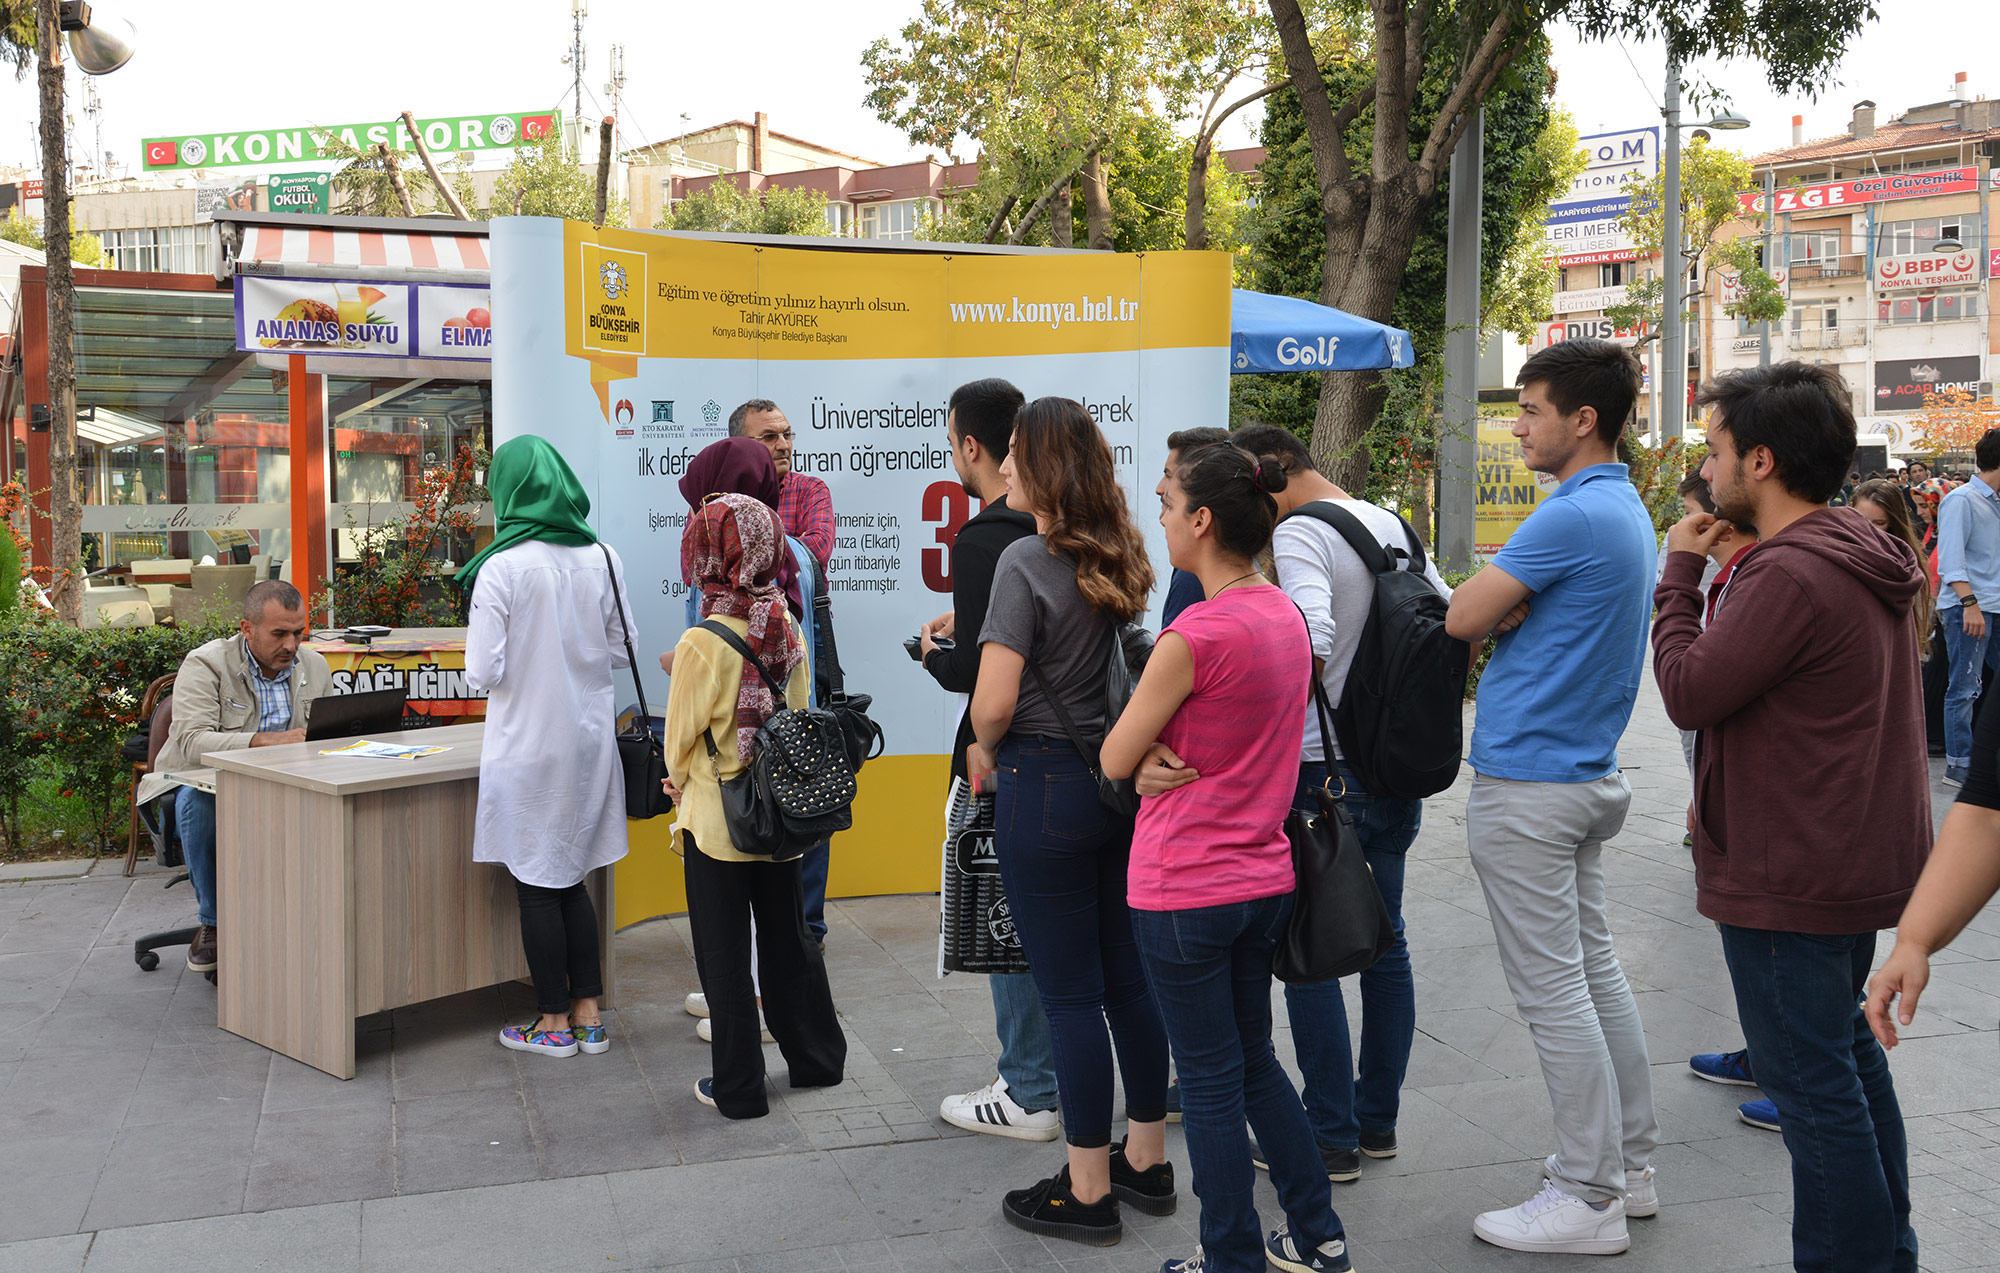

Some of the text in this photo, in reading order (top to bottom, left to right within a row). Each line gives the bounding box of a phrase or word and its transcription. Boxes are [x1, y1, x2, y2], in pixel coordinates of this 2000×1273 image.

[213, 120, 485, 164] KONYASPOR
[1597, 139, 1644, 160] OM
[283, 185, 311, 193] FUTBOL
[1853, 171, 1964, 193] Özel Güvenlik
[274, 193, 315, 205] OKULU
[1558, 207, 1591, 218] KARİYER
[1545, 223, 1578, 240] LERİ
[1580, 237, 1617, 250] LİSESİ
[1559, 254, 1609, 265] HAZIRLIK
[1905, 259, 1948, 274] BBP
[1880, 273, 1973, 288] KONYA İL TEŞKİLATI
[657, 282, 910, 312] Eğitim ve öğretim yılınız hayırlı olsun.
[739, 310, 818, 328] Tahir AKYÜREK
[949, 295, 1138, 329] www.konya.bel.tr
[255, 319, 398, 344] ANANAS SUYU
[600, 332, 629, 343] ELEDİYESİ
[712, 326, 848, 344] Konya Büyükşehir Belediye Başkanı
[1276, 336, 1340, 367] Golf
[1894, 383, 1933, 395] ACAR
[1935, 381, 1978, 393] HOME
[811, 396, 950, 430] Üniversiteleri
[639, 447, 655, 476] ilk
[792, 449, 842, 472] tıran
[1476, 486, 1535, 505] MANI
[877, 513, 901, 532] için,
[860, 533, 900, 552] (Elkart)
[829, 555, 901, 573] gün itibariyle
[662, 579, 669, 595] 3
[332, 664, 489, 699] SAĞLIĞIN
